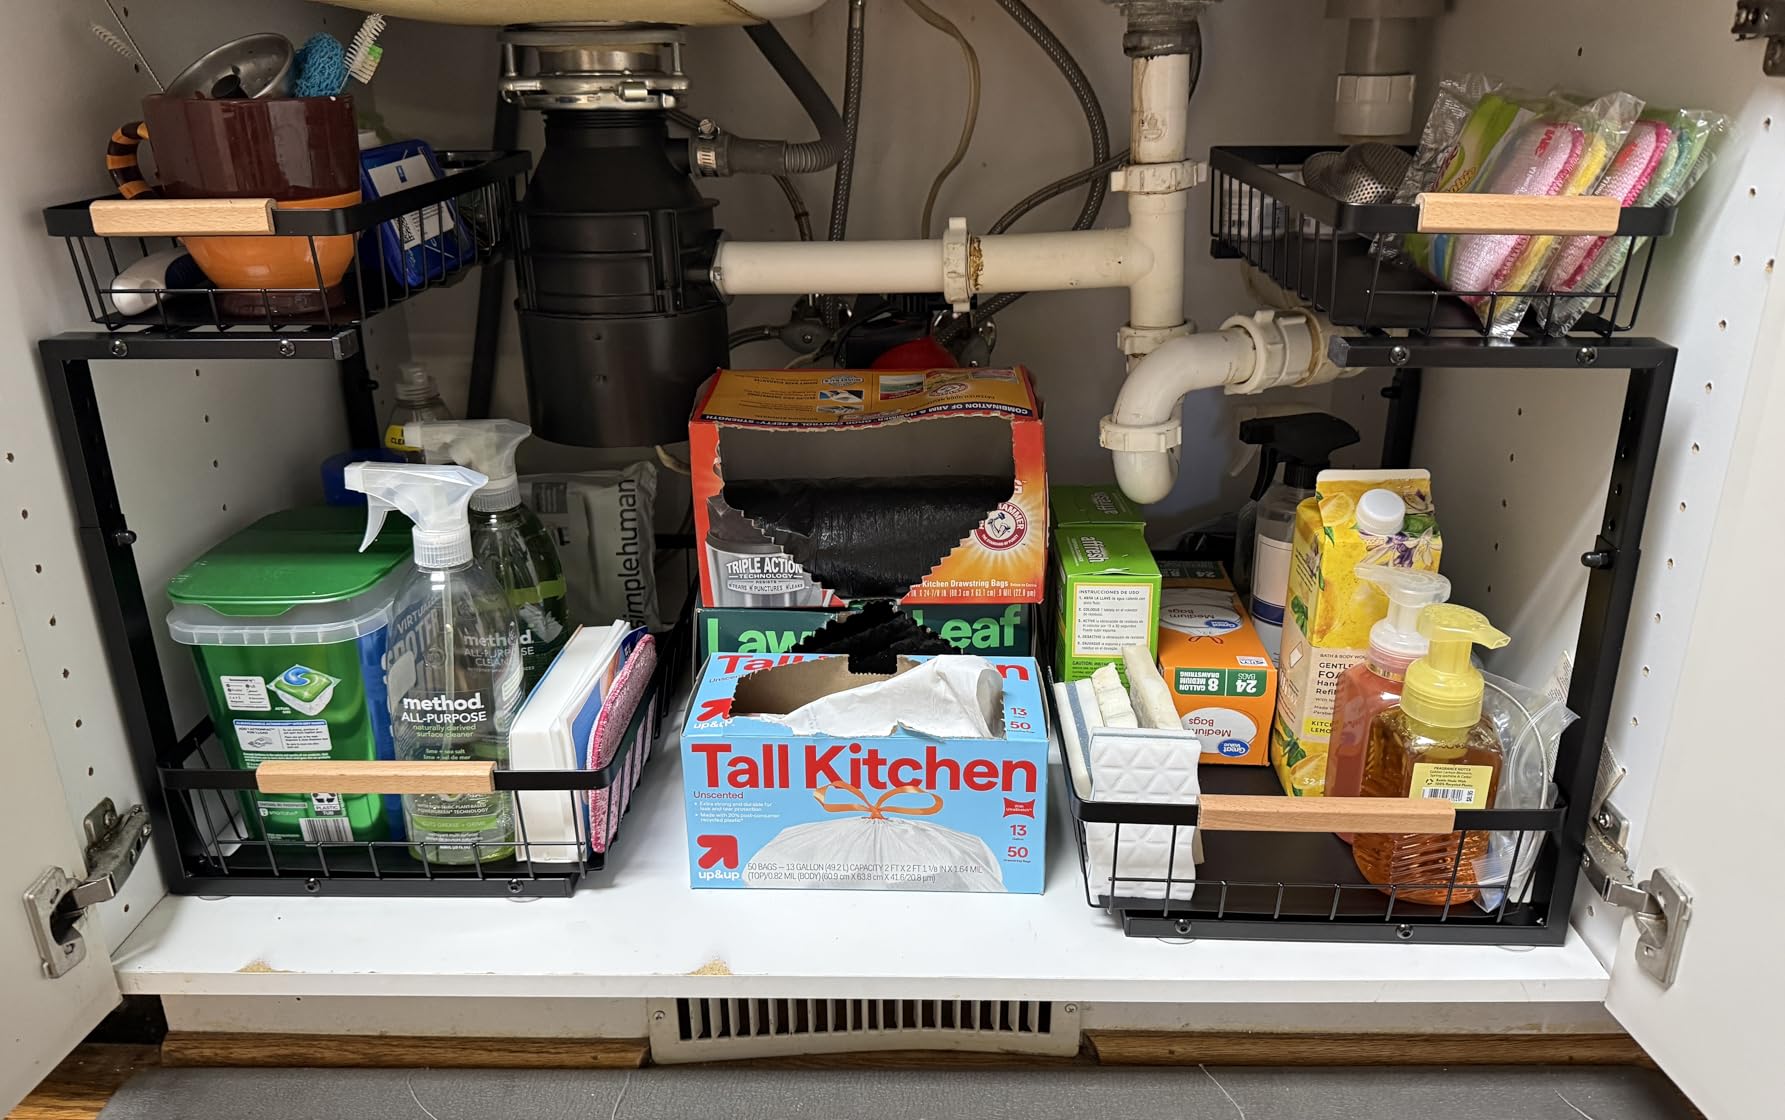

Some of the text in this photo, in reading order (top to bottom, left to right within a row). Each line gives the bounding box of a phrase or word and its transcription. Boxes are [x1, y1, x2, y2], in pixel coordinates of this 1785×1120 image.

[1534, 129, 1555, 156] 3M
[928, 405, 949, 413] ARM
[966, 402, 1028, 415] COMBINATION
[705, 414, 754, 424] STRENGTH
[616, 478, 646, 628] simplehuman
[1081, 536, 1109, 563] affresh
[726, 557, 803, 574] TRIPLE ACTION
[922, 580, 949, 588] Kitchen
[950, 580, 990, 589] Drawstring
[991, 579, 1009, 588] Bags
[708, 618, 812, 654] Law
[464, 646, 535, 657] ALL-PURPSE
[1208, 678, 1219, 691] 8
[1236, 680, 1257, 693] 24
[1010, 707, 1028, 716] 13
[401, 711, 487, 724] ALL-PURPOSE
[1189, 718, 1214, 727] Bags
[1010, 721, 1031, 730] 50
[1223, 745, 1246, 754] Great
[691, 741, 1037, 793] Tall Kitchen
[693, 791, 744, 799] Unscented
[1010, 824, 1027, 836] 13
[1007, 846, 1028, 858] 50
[747, 863, 757, 871] 50
[758, 863, 777, 871] BAGS
[786, 863, 795, 871] 13
[796, 863, 824, 871] GALLON
[825, 863, 842, 872] (49.2
[842, 863, 849, 872] L)
[850, 864, 883, 872] CAPACITY
[884, 864, 889, 872] 2
[890, 864, 899, 872] FT
[900, 864, 906, 872] X
[906, 864, 911, 872] 2
[912, 864, 920, 872] FT
[947, 864, 952, 873] X
[953, 865, 968, 873] 1.64
[969, 865, 982, 874] MIL
[698, 870, 740, 880] up&up
[797, 873, 821, 882] (BODY)
[822, 873, 838, 882] (60.9
[851, 873, 856, 881] X
[884, 874, 890, 882] X
[890, 874, 922, 882] 41.6/20.8
